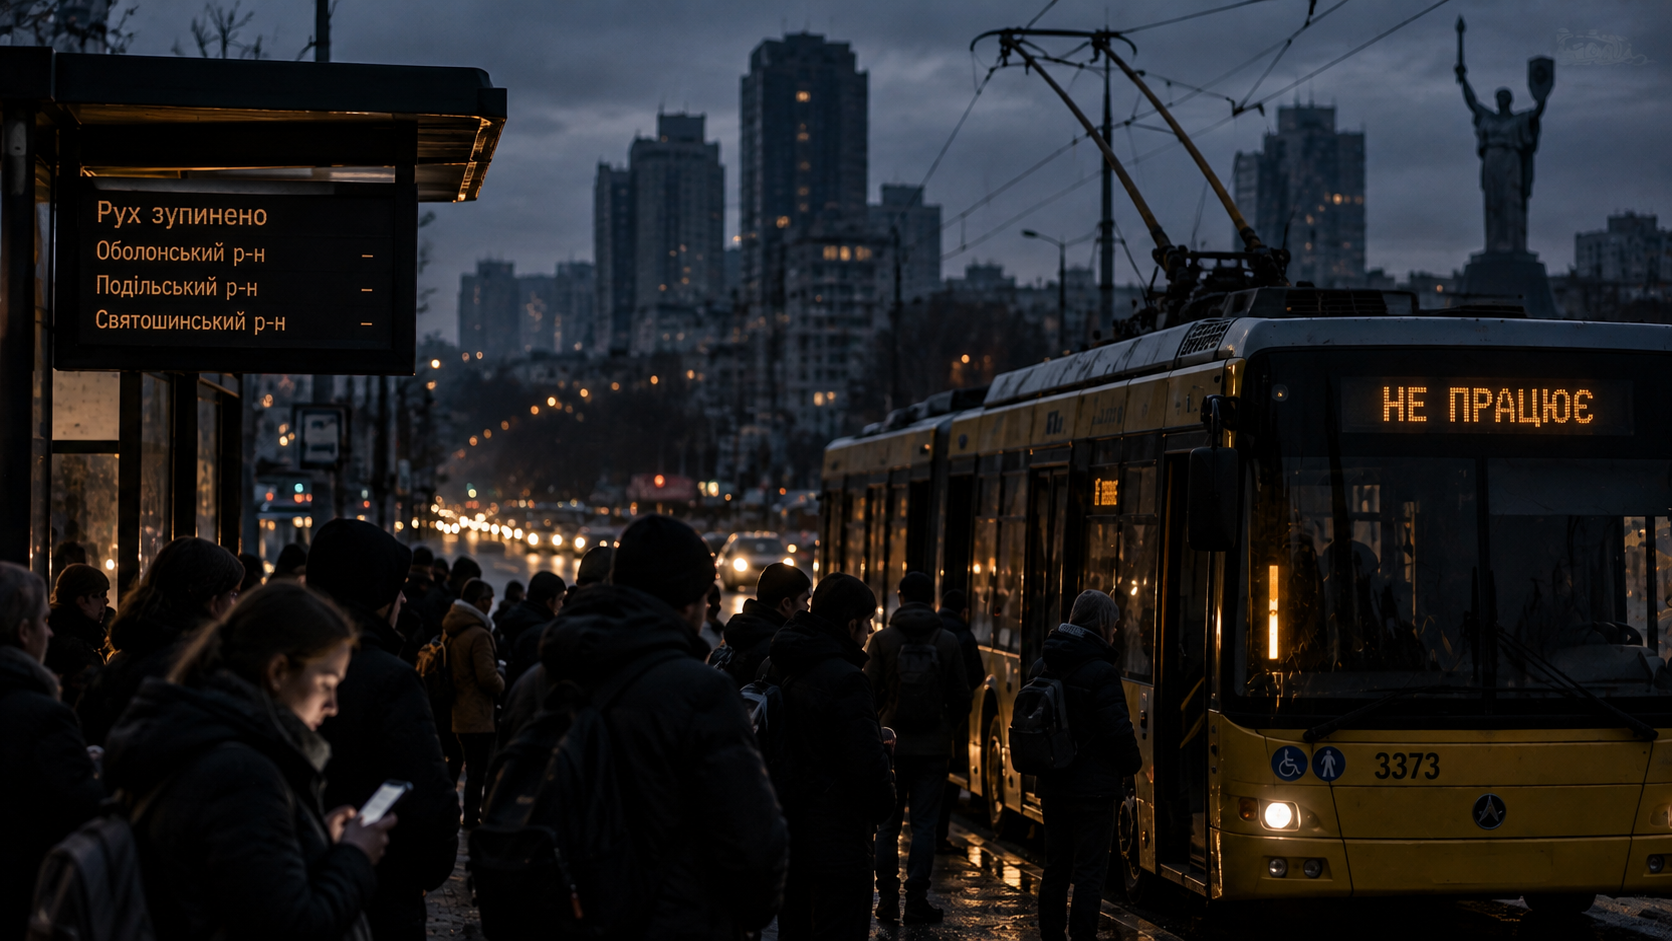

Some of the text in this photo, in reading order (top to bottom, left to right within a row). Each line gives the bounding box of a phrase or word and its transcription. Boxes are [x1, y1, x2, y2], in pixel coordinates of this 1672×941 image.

[97, 200, 268, 229] Рух зупинено
[96, 240, 225, 262] Оболонський
[233, 247, 265, 266] р-н
[96, 274, 217, 298] Подільський
[226, 281, 258, 301] р-н
[95, 309, 246, 331] Святошинський
[254, 316, 286, 335] р-н
[1382, 386, 1595, 428] НЕ ПРАЦЮЄ
[1374, 752, 1441, 780] 3373
